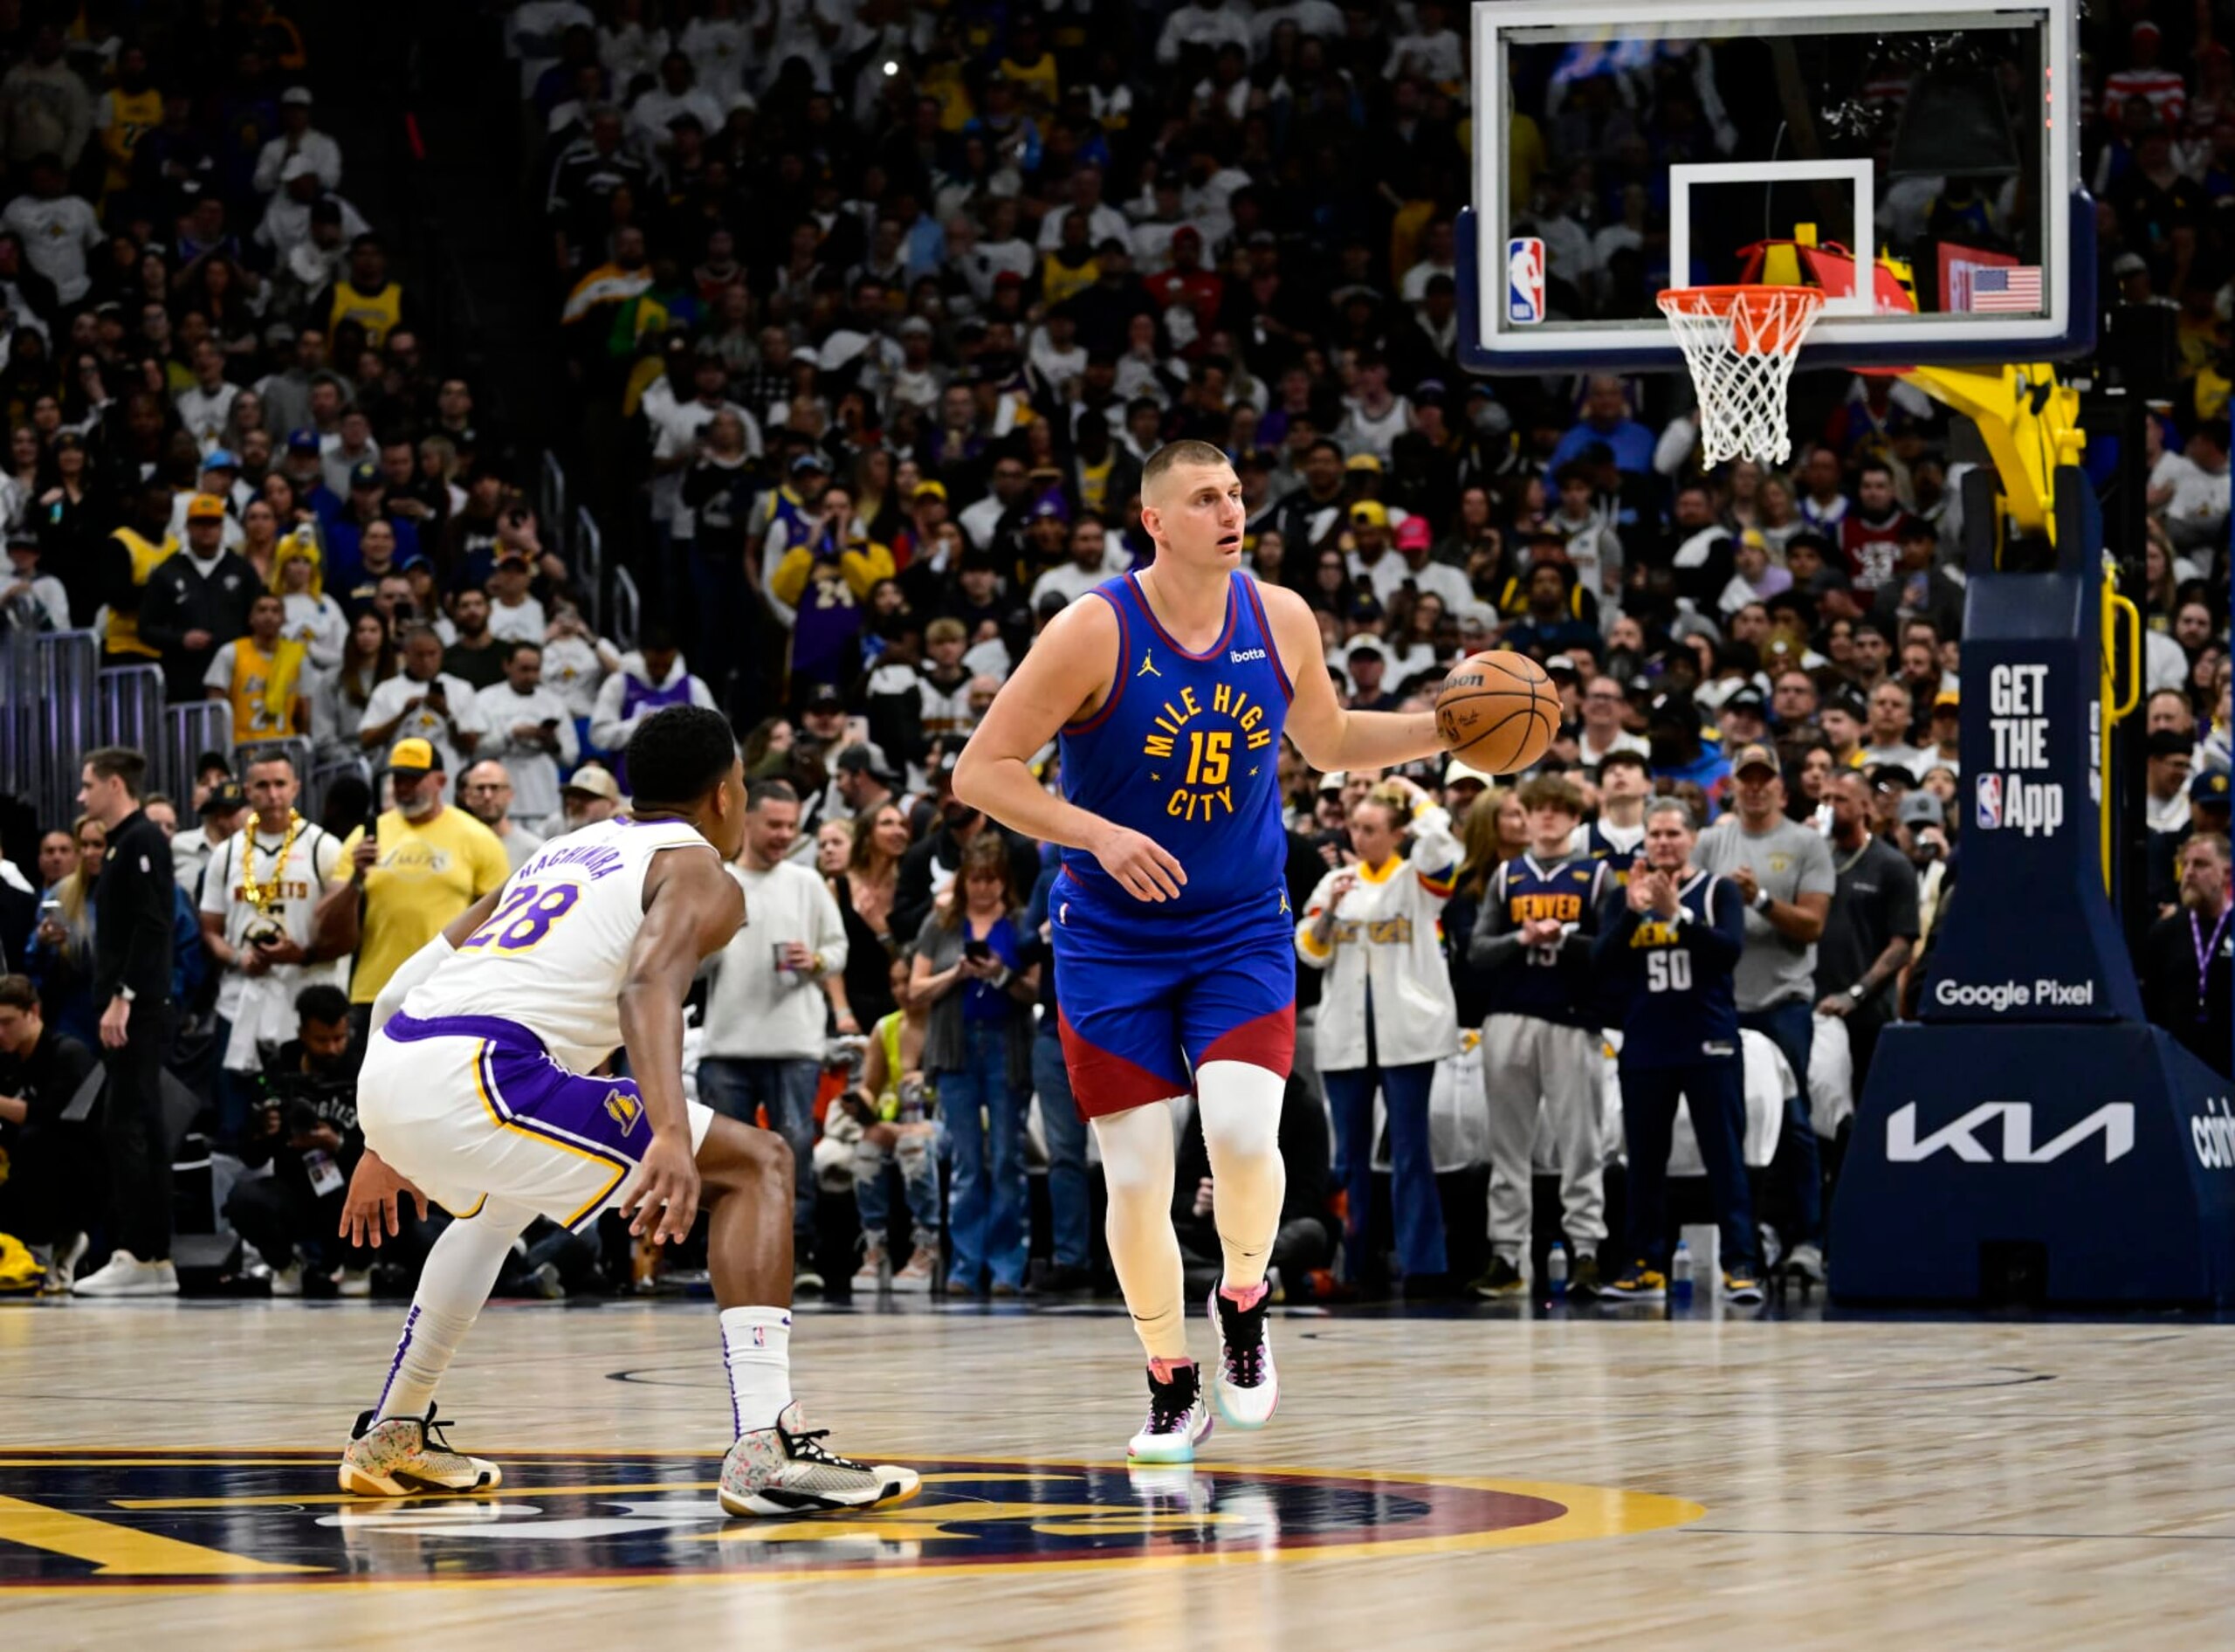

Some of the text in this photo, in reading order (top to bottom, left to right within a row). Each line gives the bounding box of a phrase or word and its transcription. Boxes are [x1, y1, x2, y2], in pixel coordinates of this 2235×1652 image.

[815, 577, 855, 609] 24
[1230, 648, 1267, 664] ibotta
[1990, 664, 2048, 716] GET
[1144, 682, 1271, 758] MILE HIGH
[1989, 719, 2049, 769] THE
[1186, 731, 1232, 784] 15
[1166, 785, 1234, 822] CITY
[2004, 773, 2063, 837] App
[460, 883, 581, 953] 28
[1510, 894, 1581, 923] DENVER
[1647, 948, 1693, 993] 50
[1936, 979, 2093, 1012] Google Pixel
[1887, 1101, 2135, 1164] KIA
